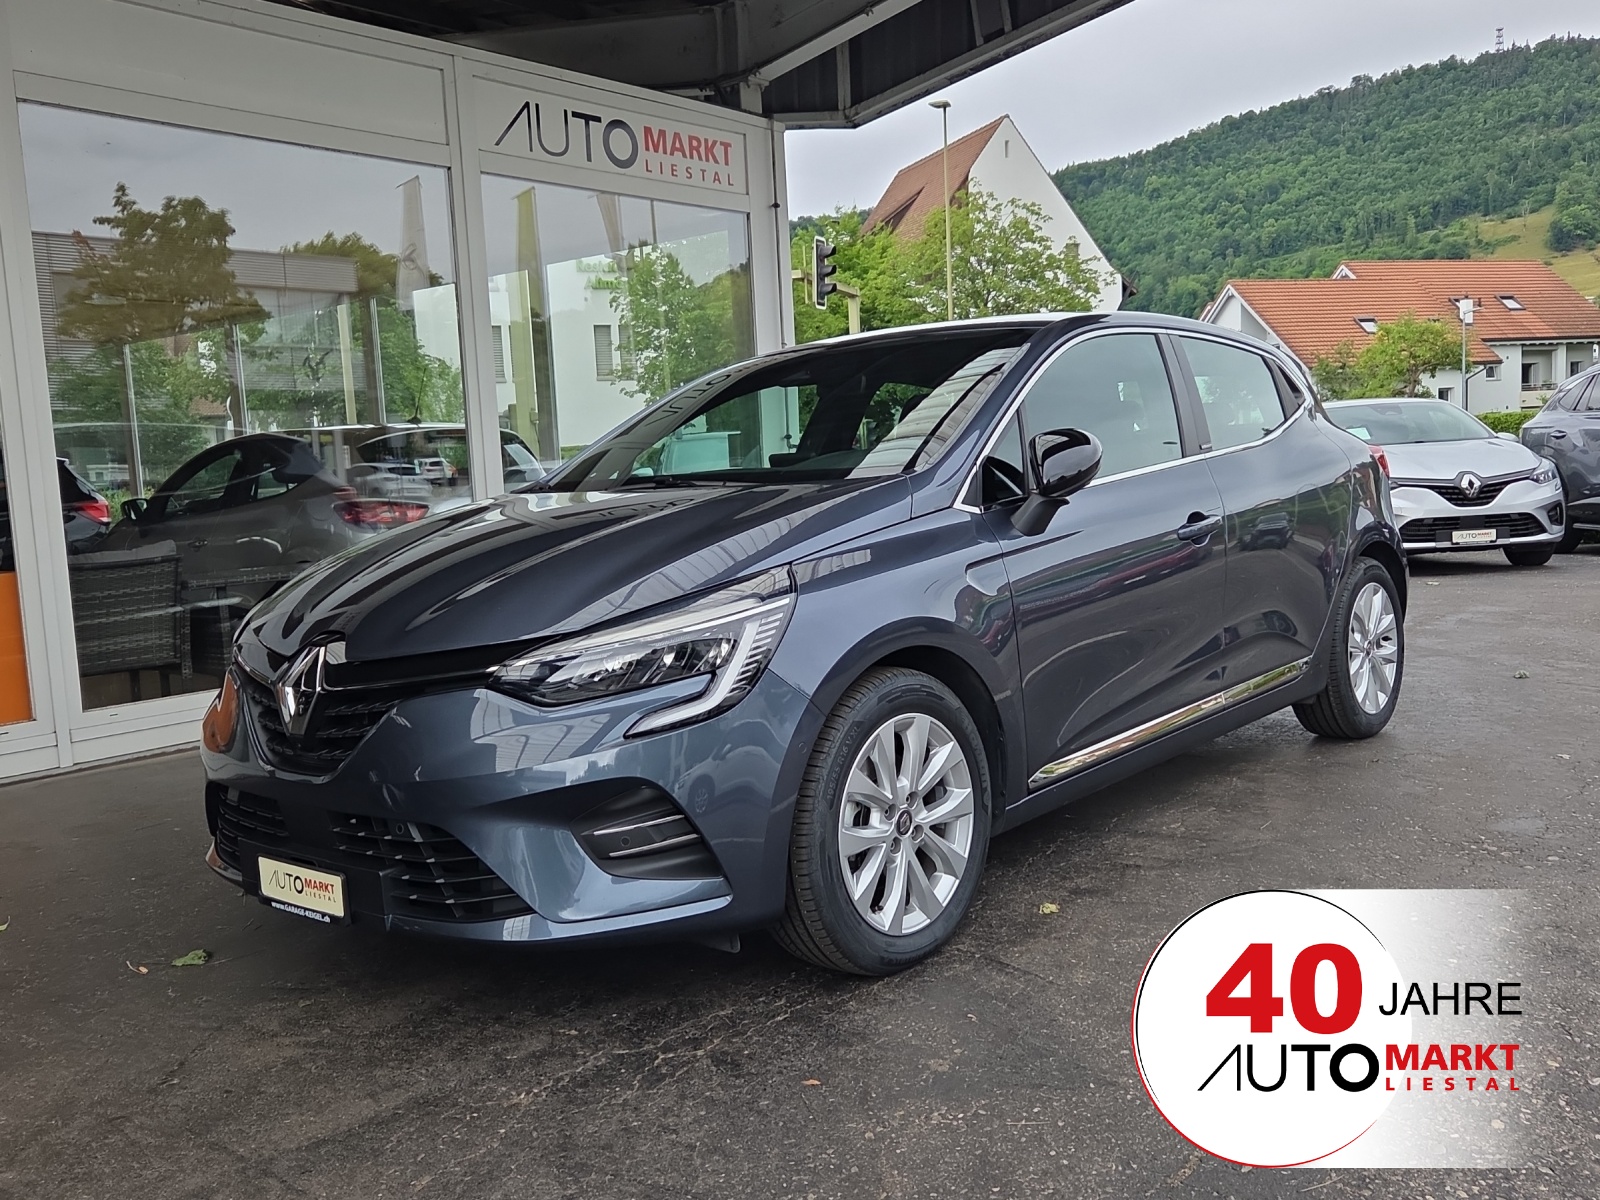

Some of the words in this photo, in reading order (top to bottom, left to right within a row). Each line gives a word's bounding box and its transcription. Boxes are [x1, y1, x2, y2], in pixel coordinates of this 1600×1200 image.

[494, 100, 639, 170] AUTO
[643, 125, 732, 167] MARKT
[645, 158, 734, 187] LIESTAL
[826, 766, 841, 800] 195/55
[838, 744, 850, 765] R16
[269, 870, 304, 894] AUTO
[304, 877, 335, 895] MARKT
[305, 890, 337, 903] LIESTAL
